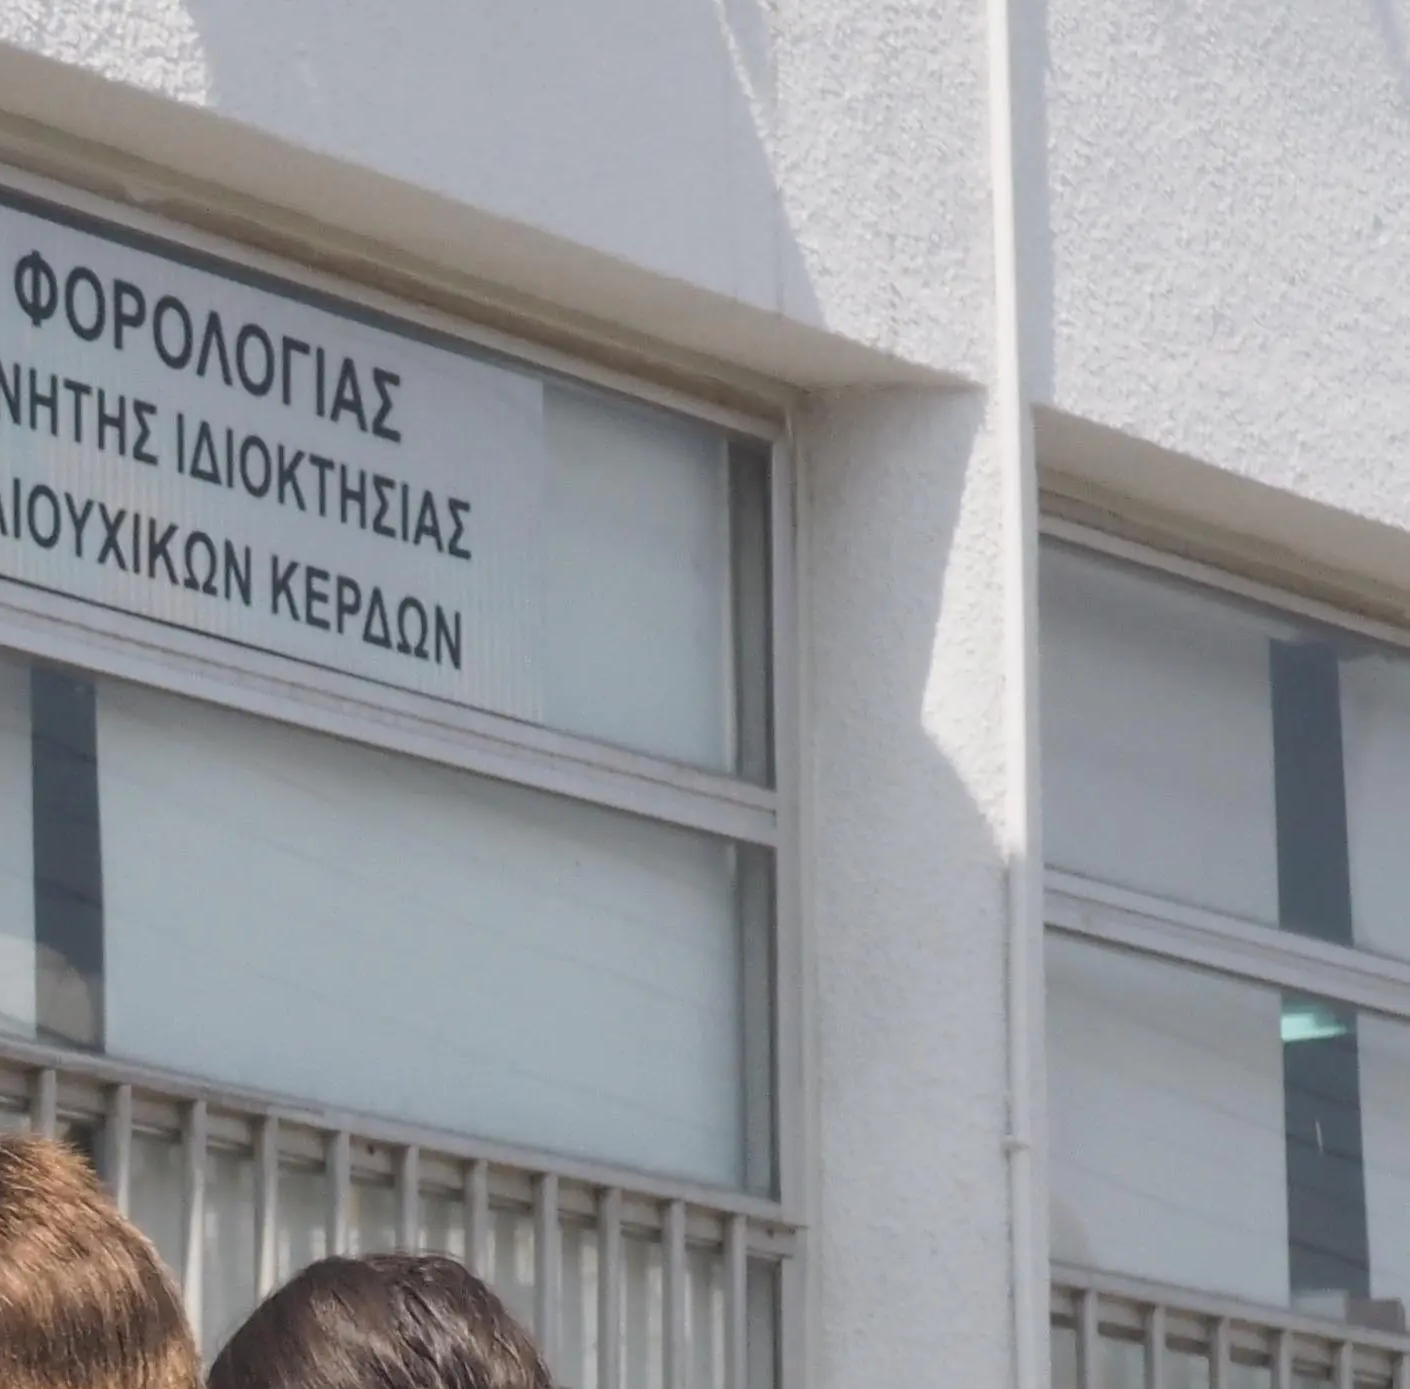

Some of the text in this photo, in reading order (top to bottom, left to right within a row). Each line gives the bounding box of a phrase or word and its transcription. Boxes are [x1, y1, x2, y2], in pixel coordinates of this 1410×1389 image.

[13, 249, 402, 444] ΦΟΡΟΛΟΓΙΑΣ
[176, 411, 472, 562] ΙΔΙΟΚΤΗΣΙΑΣ
[270, 554, 462, 671] ΚΕΡΔΩΝ
